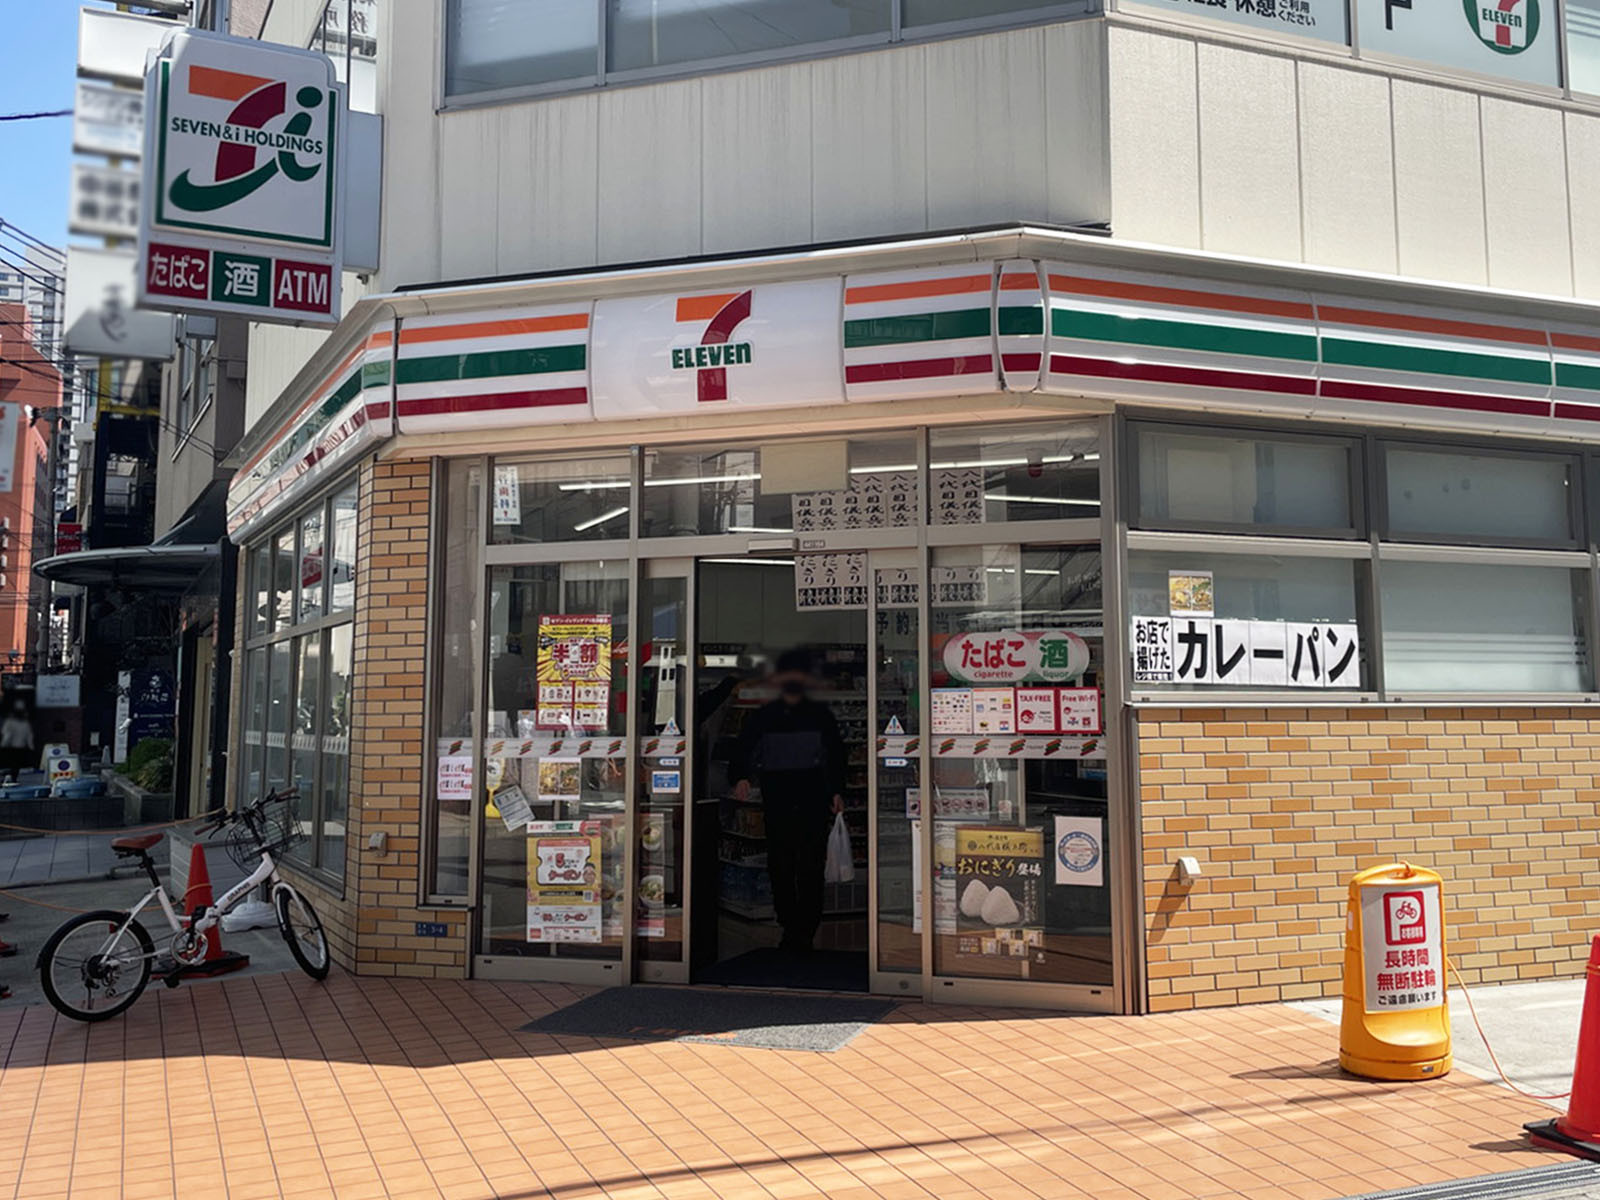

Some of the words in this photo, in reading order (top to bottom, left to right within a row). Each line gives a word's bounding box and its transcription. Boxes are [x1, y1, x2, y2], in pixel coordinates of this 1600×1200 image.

[1278, 10, 1316, 26] ください
[1482, 8, 1522, 27] ELEVEN
[171, 117, 241, 142] SEVEN&i
[245, 129, 324, 155] HOLDINGS
[150, 252, 206, 291] たばこ
[223, 260, 258, 297] 酒
[277, 268, 328, 305] ATM
[672, 342, 752, 369] ELEVEN
[1136, 620, 1169, 645] お店で
[961, 638, 1027, 668] たばこ
[1039, 638, 1069, 668] 酒
[1136, 646, 1171, 670] 揚げた
[1177, 621, 1356, 683] カレーパン
[974, 669, 1014, 679] cigarette
[1062, 694, 1077, 702] Free
[956, 857, 1015, 878] おにぎり
[1385, 948, 1429, 969] 長時間
[1377, 969, 1436, 991] 無断駐輪
